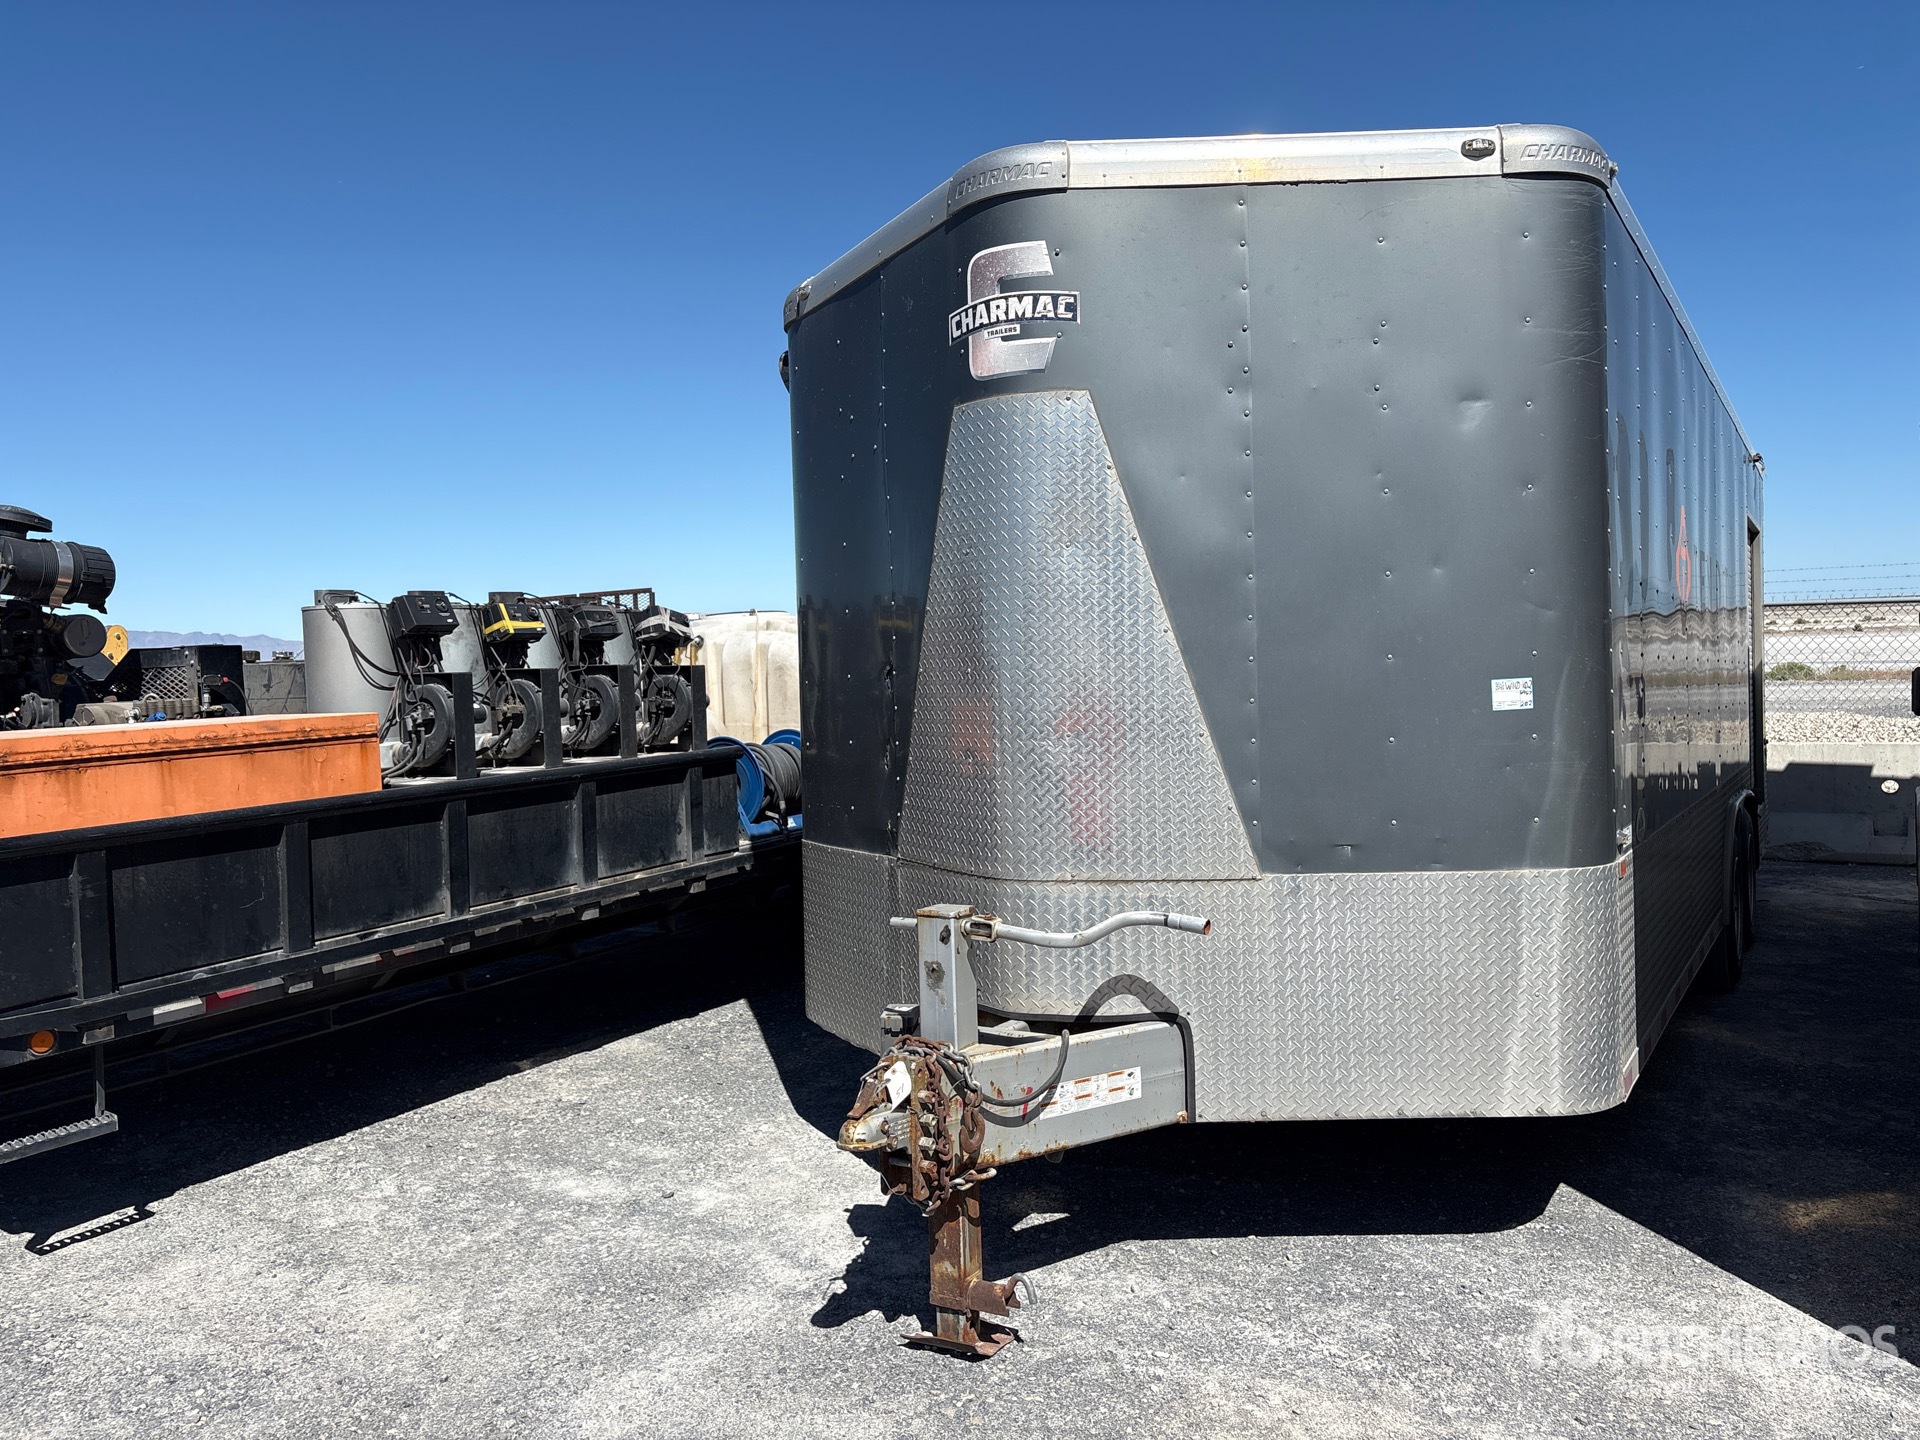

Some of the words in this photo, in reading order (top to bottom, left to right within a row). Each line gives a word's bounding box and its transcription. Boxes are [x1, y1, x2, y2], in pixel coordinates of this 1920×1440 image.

[1520, 143, 1607, 172] CHARMAC
[955, 161, 1053, 200] CHARMAC
[951, 295, 1075, 339] CHARMAC
[986, 326, 1018, 338] TRAILERS
